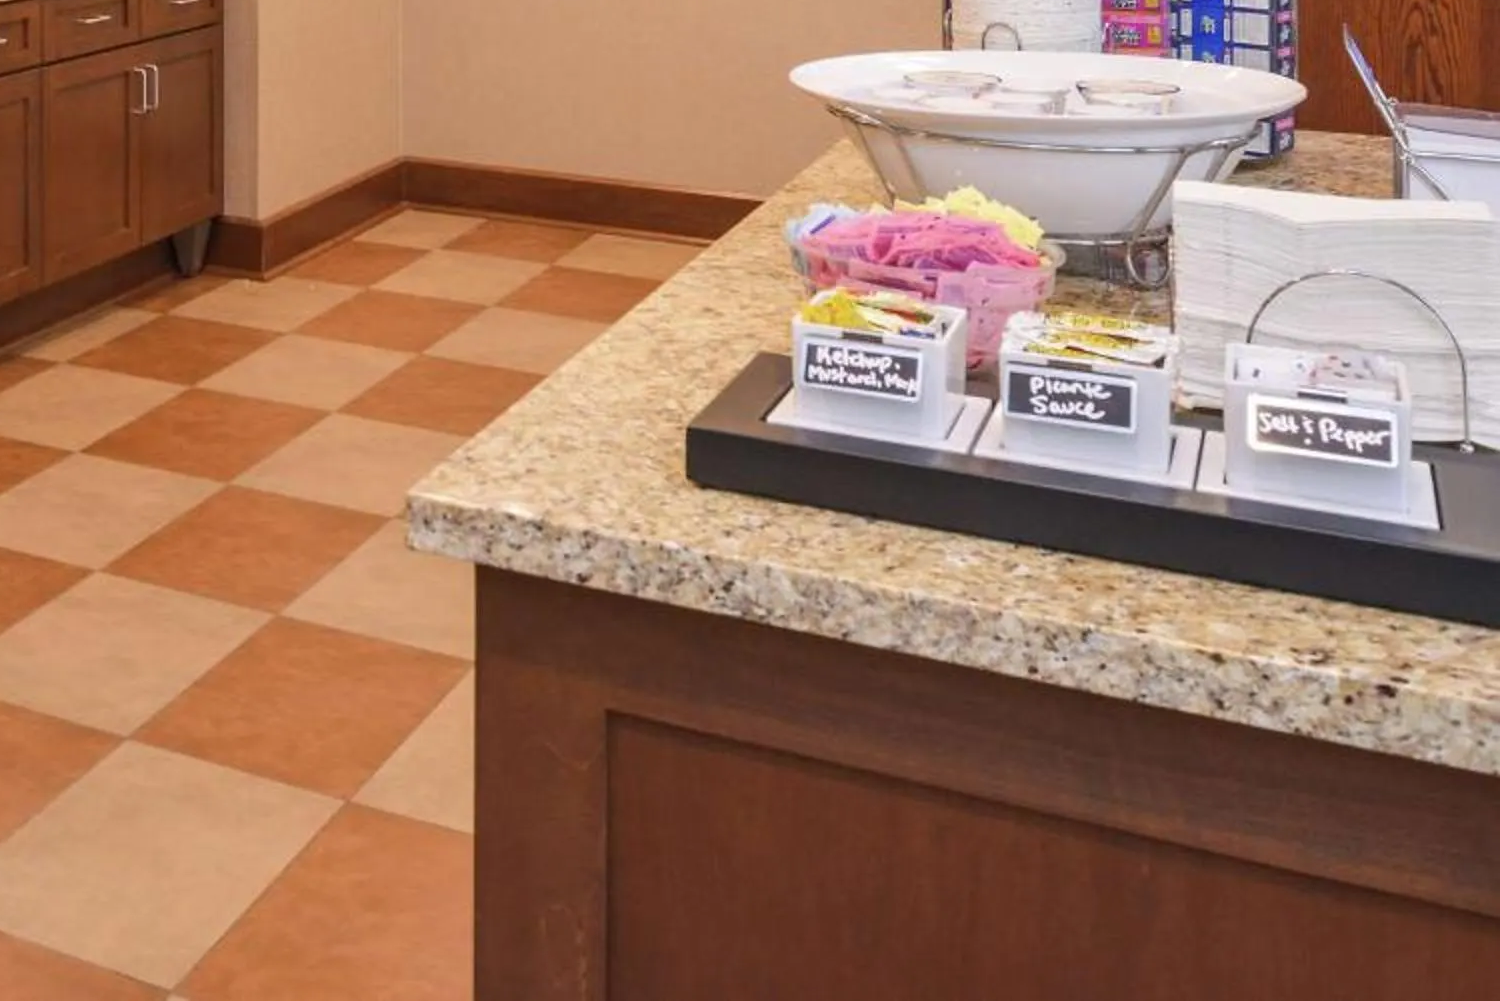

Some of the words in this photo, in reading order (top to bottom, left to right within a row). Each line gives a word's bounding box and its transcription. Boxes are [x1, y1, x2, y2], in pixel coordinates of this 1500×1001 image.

[1029, 375, 1112, 399] Picante
[1029, 394, 1106, 419] Sauce
[1318, 417, 1391, 453] Pepper
